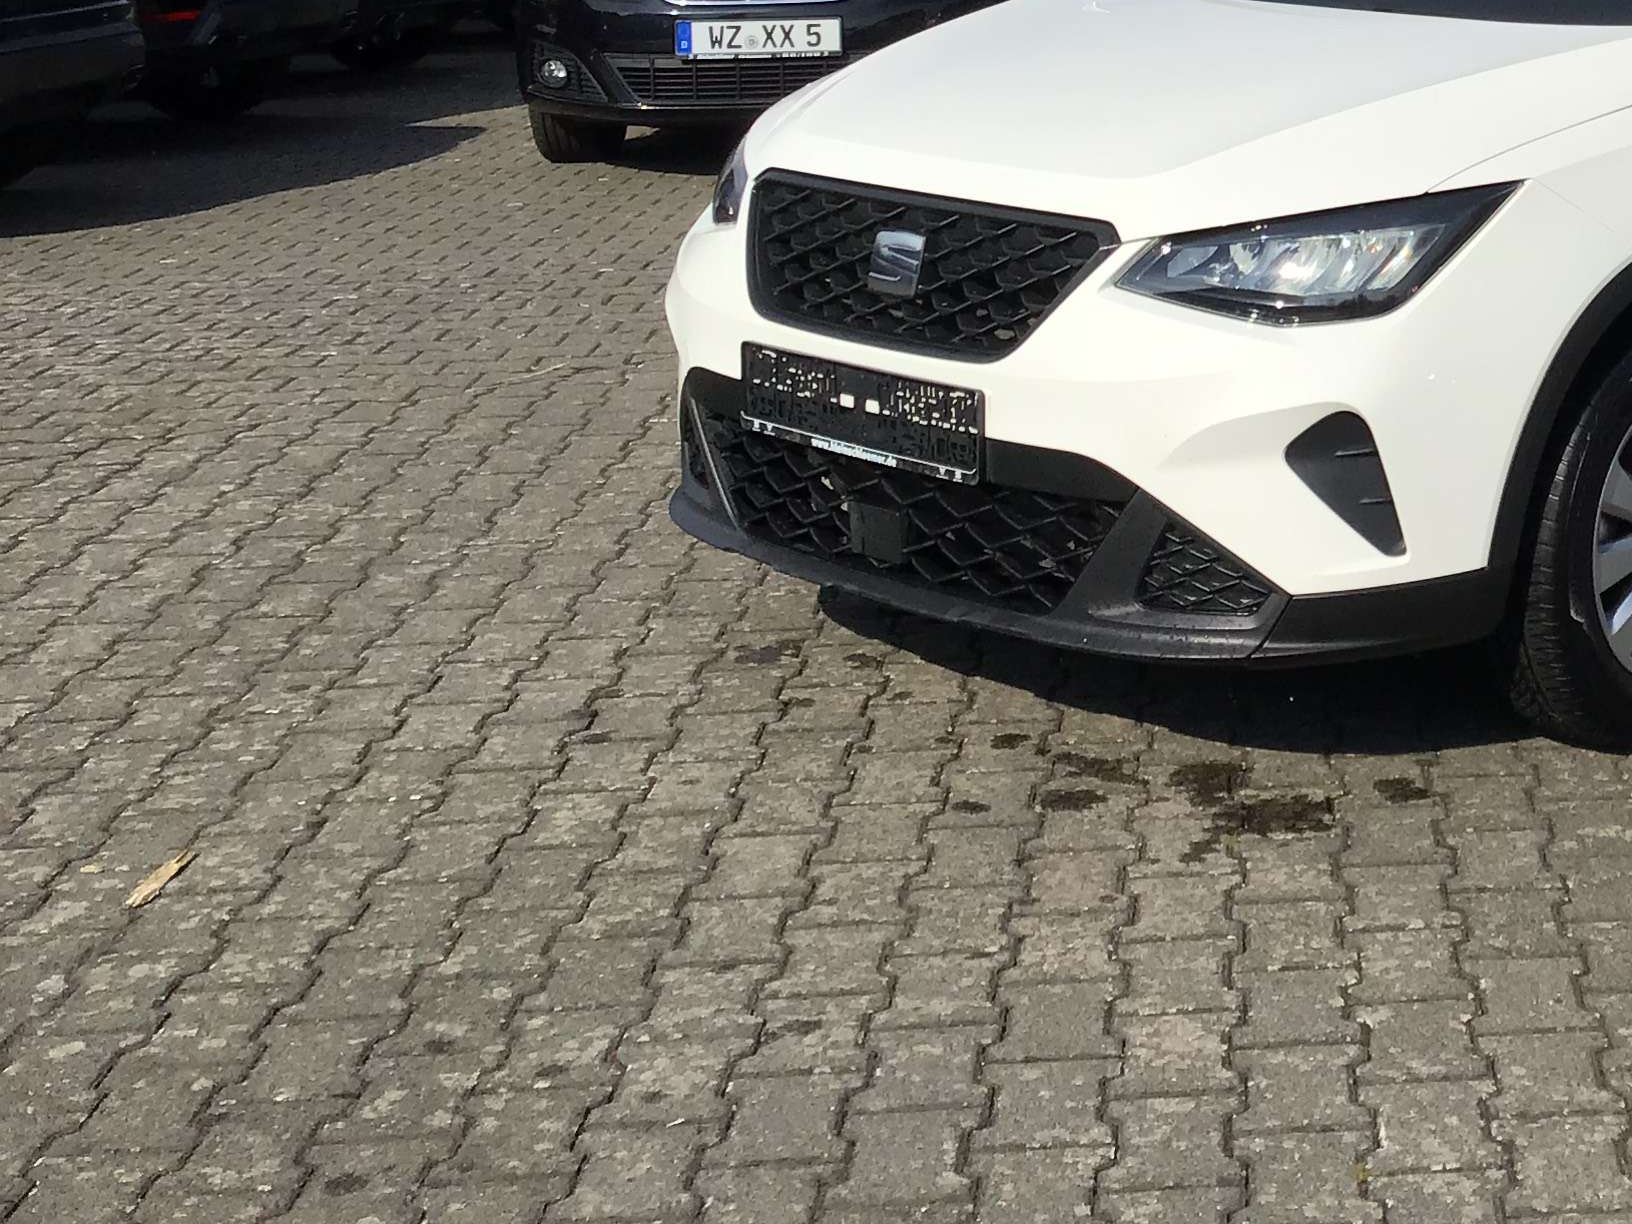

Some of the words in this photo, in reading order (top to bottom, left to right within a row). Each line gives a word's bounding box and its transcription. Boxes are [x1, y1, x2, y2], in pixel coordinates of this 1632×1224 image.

[709, 25, 742, 49] WZ
[762, 24, 795, 48] XX
[806, 23, 821, 47] 5
